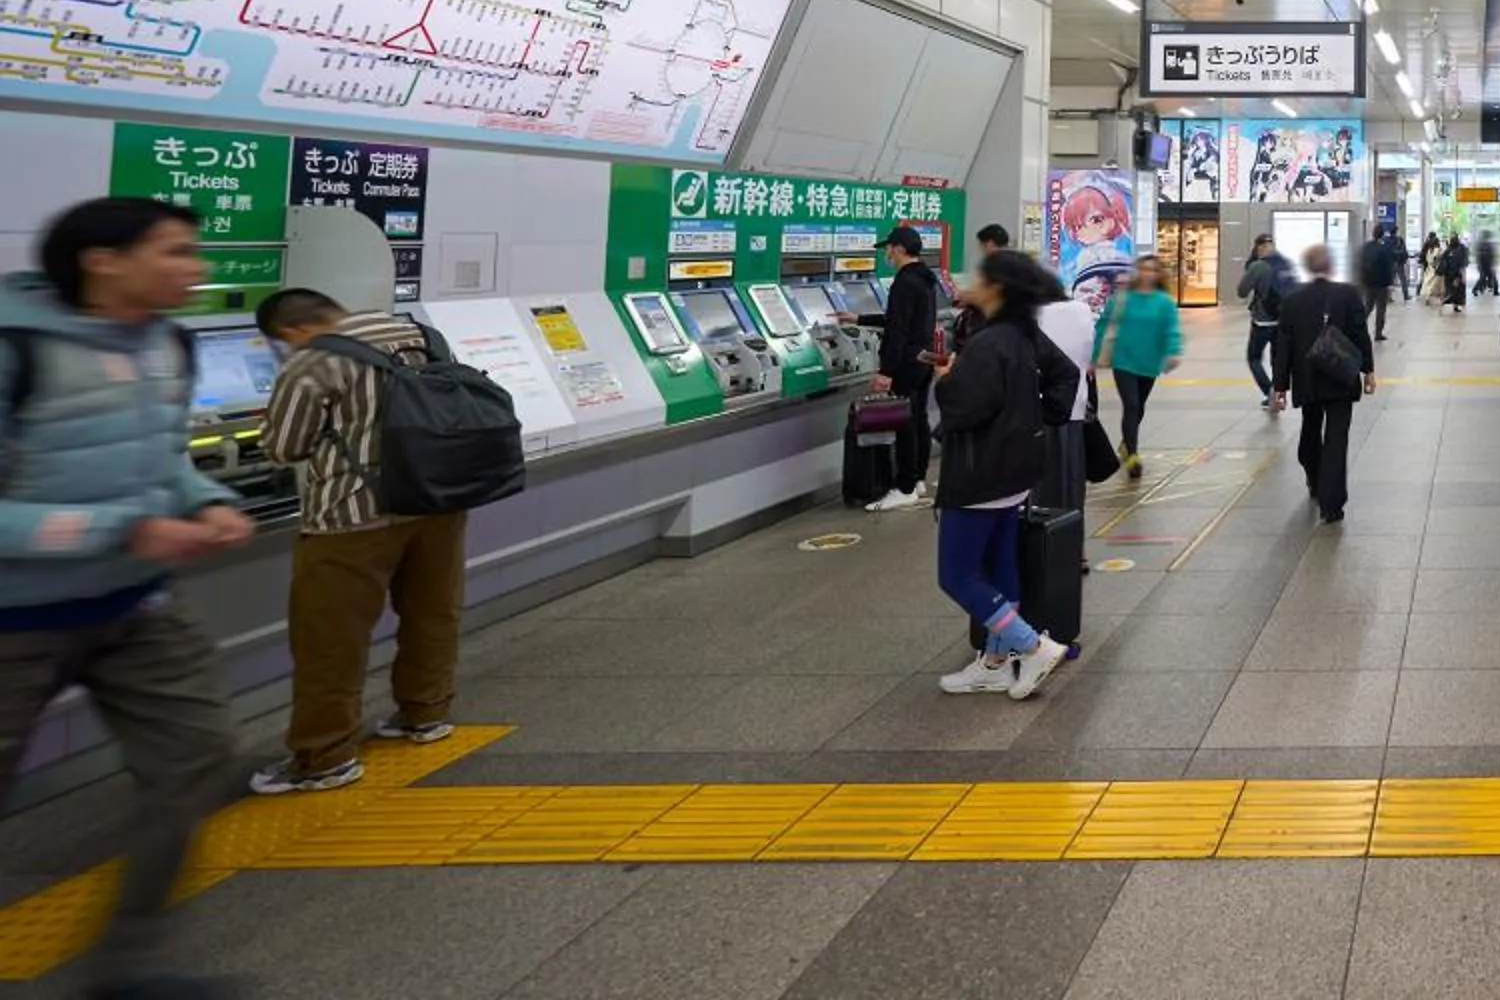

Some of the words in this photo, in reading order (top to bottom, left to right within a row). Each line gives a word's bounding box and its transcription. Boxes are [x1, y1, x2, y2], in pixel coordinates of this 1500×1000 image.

[1206, 45, 1321, 65] きっぷうりば
[1206, 70, 1251, 81] Tickets
[153, 137, 259, 169] きっぷ
[305, 147, 359, 175] きっぷ
[368, 152, 418, 181] 定期券
[169, 171, 240, 190] Tickets
[311, 178, 350, 195] Tickets
